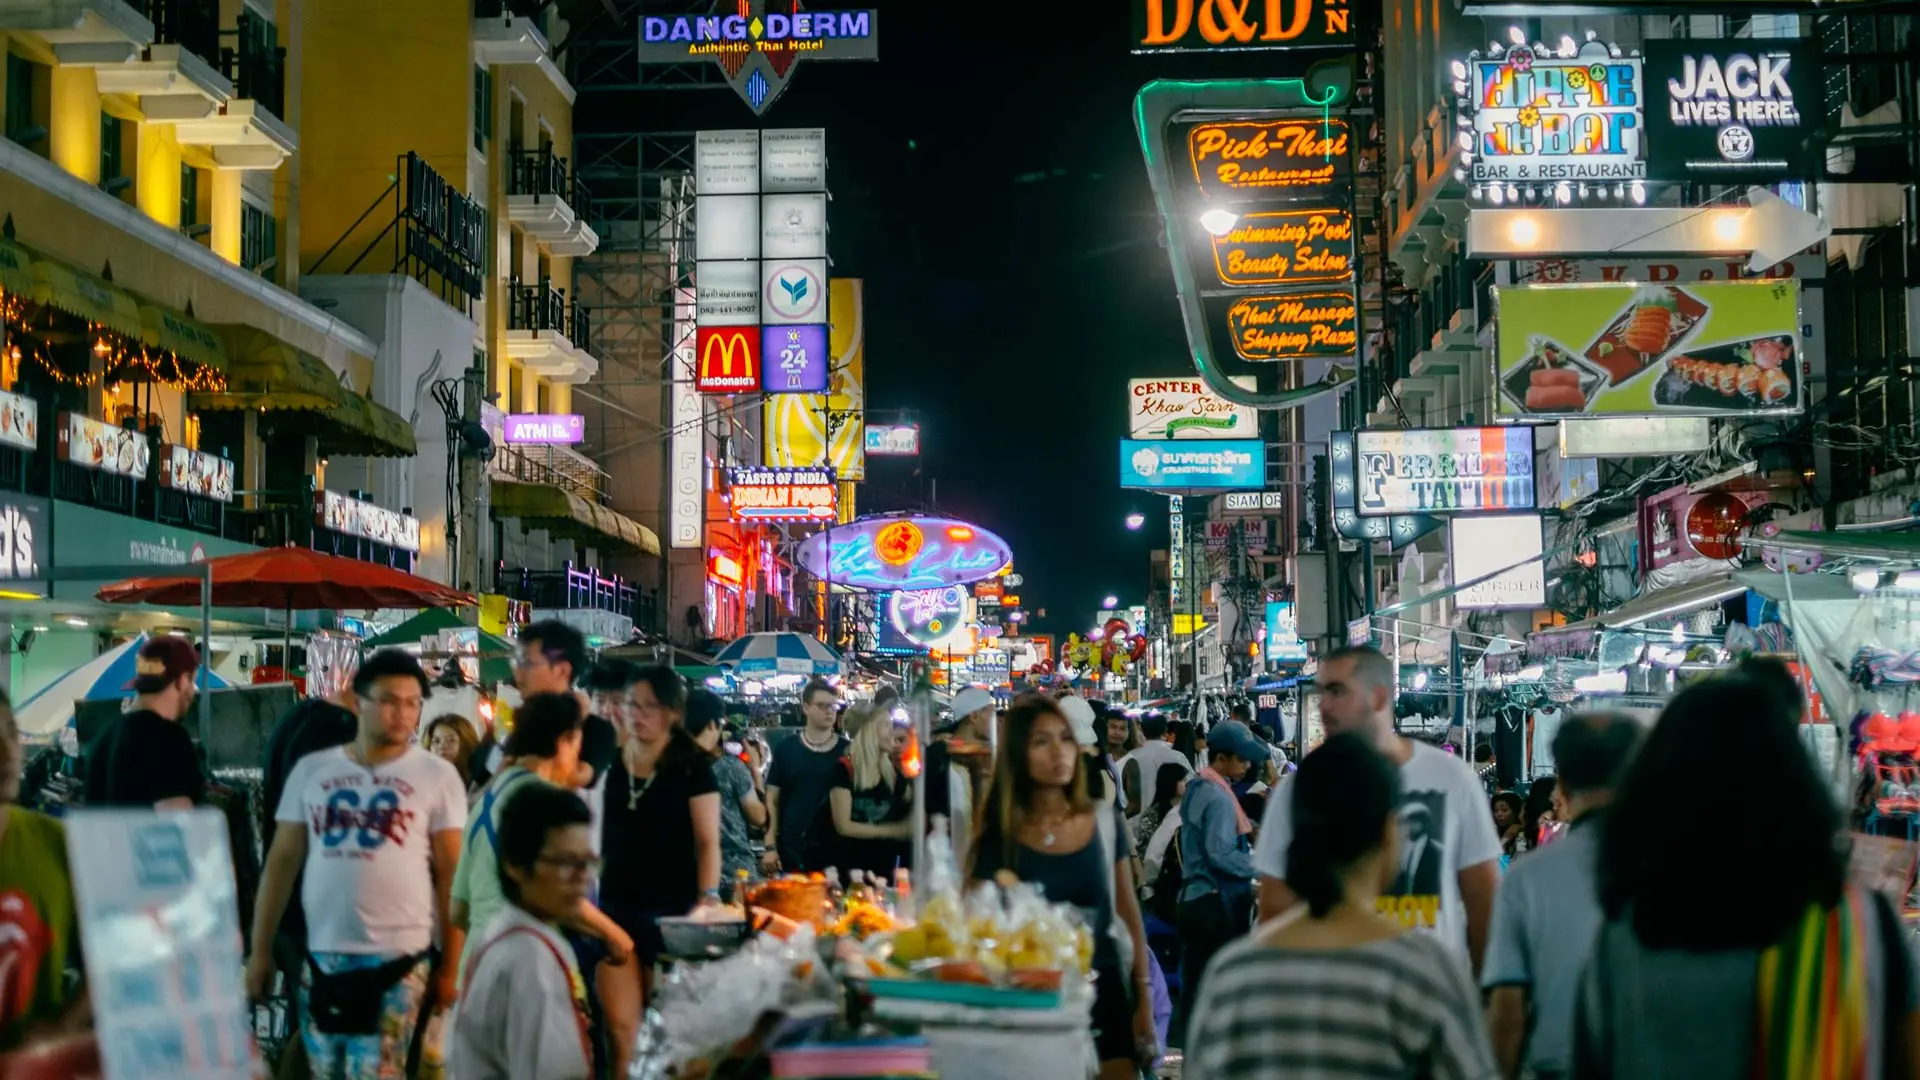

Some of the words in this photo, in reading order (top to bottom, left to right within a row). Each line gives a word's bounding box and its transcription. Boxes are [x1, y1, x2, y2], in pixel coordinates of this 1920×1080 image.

[645, 15, 747, 41] DANG
[766, 12, 869, 38] DERM
[689, 43, 749, 54] Authentic
[756, 41, 783, 51] Thai
[789, 40, 823, 50] Hotel
[1669, 55, 1793, 98] JACK
[1671, 101, 1731, 121] LIVES
[1736, 100, 1800, 121] HERE.
[1197, 125, 1348, 160] Pick-Thai
[1216, 163, 1335, 184] Restaurant
[1476, 165, 1509, 178] BAR
[1518, 165, 1530, 178] &
[1539, 163, 1645, 178] RESTAURANT
[1308, 214, 1351, 241] Pool
[1227, 249, 1289, 278] Beauty
[1293, 247, 1347, 271] Salon
[1234, 303, 1276, 326] Thai
[1277, 302, 1356, 325] Massage
[1242, 328, 1309, 353] Shopping
[1310, 324, 1356, 345] Plaza
[780, 350, 808, 368] 24
[701, 376, 755, 386] McDonald's
[1134, 382, 1203, 396] CENTER
[1136, 397, 1185, 416] Khao
[1191, 396, 1239, 415] Sarn
[514, 423, 548, 438] ATM
[737, 473, 773, 485] TASTE
[776, 473, 792, 485] OF
[794, 472, 829, 485] INDIA
[679, 452, 698, 542] FOOD
[734, 487, 789, 506] INDIAN
[791, 487, 833, 506] FOOD
[1228, 495, 1260, 507] SIAM
[975, 652, 1007, 665] BAG
